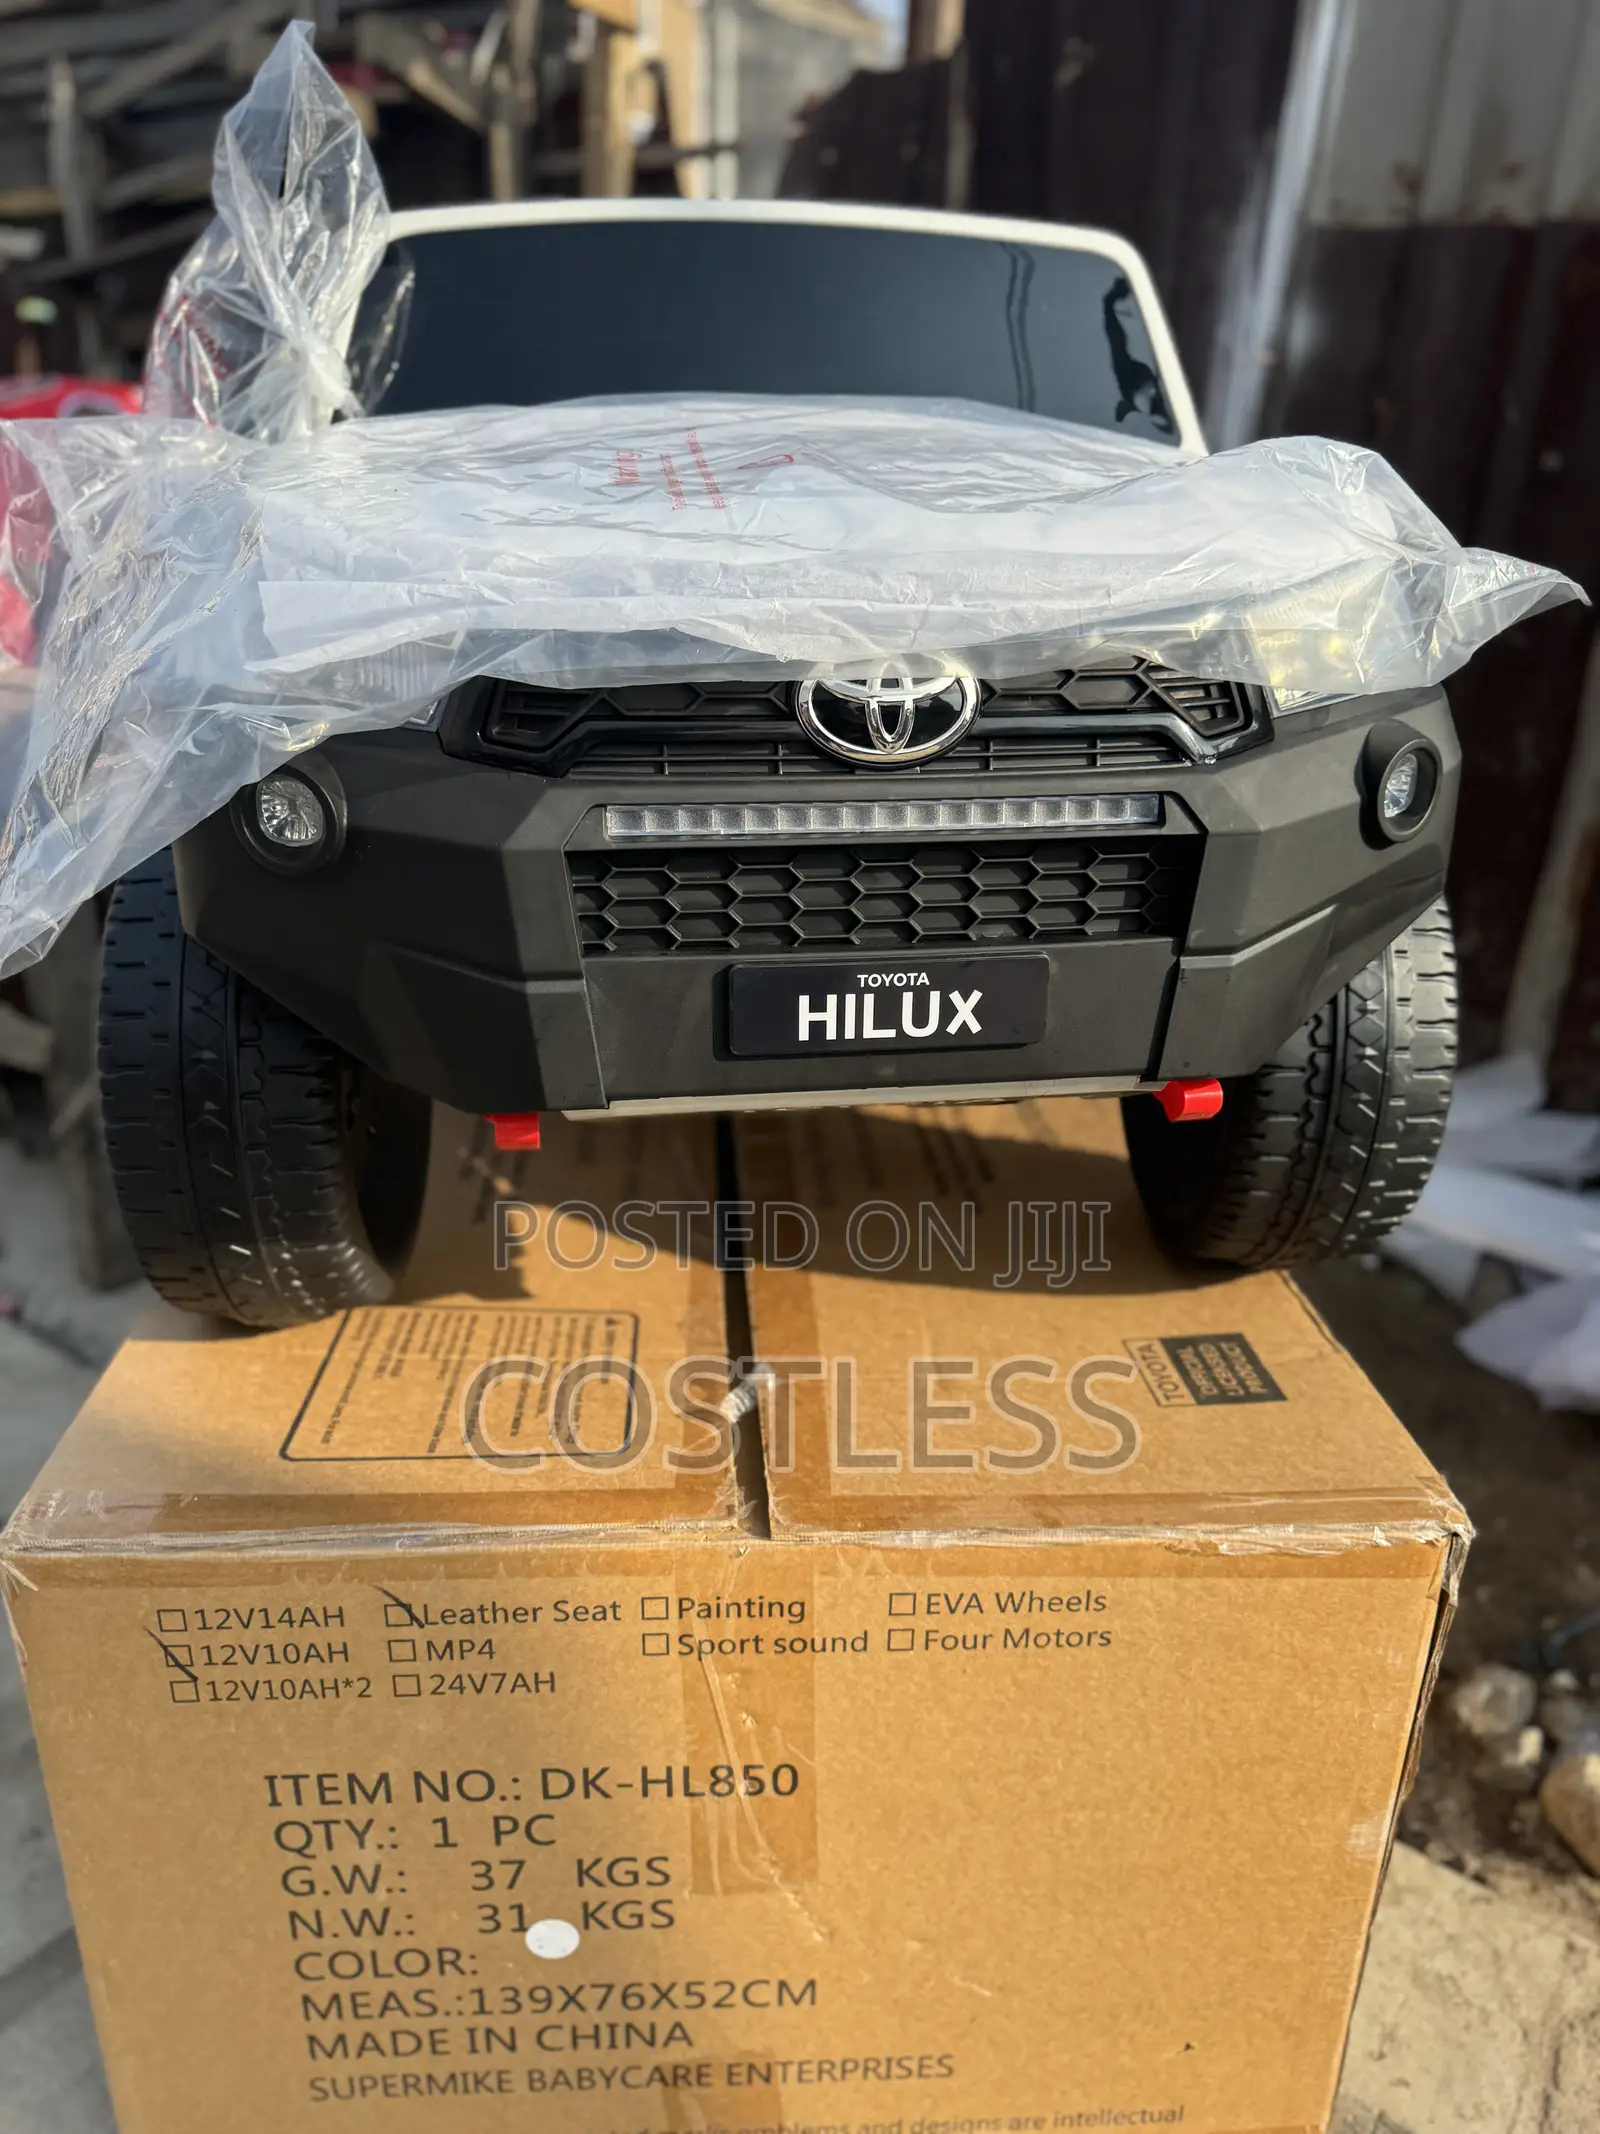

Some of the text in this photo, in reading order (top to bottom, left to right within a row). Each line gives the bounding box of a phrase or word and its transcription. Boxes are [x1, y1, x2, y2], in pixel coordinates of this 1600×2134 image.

[857, 972, 930, 987] TOYOTA
[798, 989, 983, 1041] HILUX
[423, 1600, 621, 1625] Leather Seat
[677, 1595, 806, 1624] Painting
[925, 1590, 1108, 1615] EVA Wheels
[194, 1606, 345, 1630] 12V14AH
[426, 1638, 496, 1661] MP4
[677, 1630, 868, 1661] Sport sound
[925, 1626, 1112, 1651] Four Motors
[200, 1642, 349, 1666] 12V10AH
[429, 1671, 556, 1696] 24V7AH
[264, 1763, 799, 1807] ITEM NO.: DK-HL850
[274, 1813, 556, 1859] QTY.: 1 PC
[281, 1856, 671, 1897] G.W.: 37 KGS
[288, 1898, 676, 1940] N.W.: 31 KGS
[294, 1947, 479, 1981] COLOR:
[307, 2021, 694, 2060] MADE IN CHINA
[308, 2054, 955, 2102] SUPERMIKE BABYCARE ENTERPRISES
[909, 2113, 1001, 2134] designs
[1008, 2115, 1048, 2131] are
[1053, 2104, 1184, 2129] intellectual
